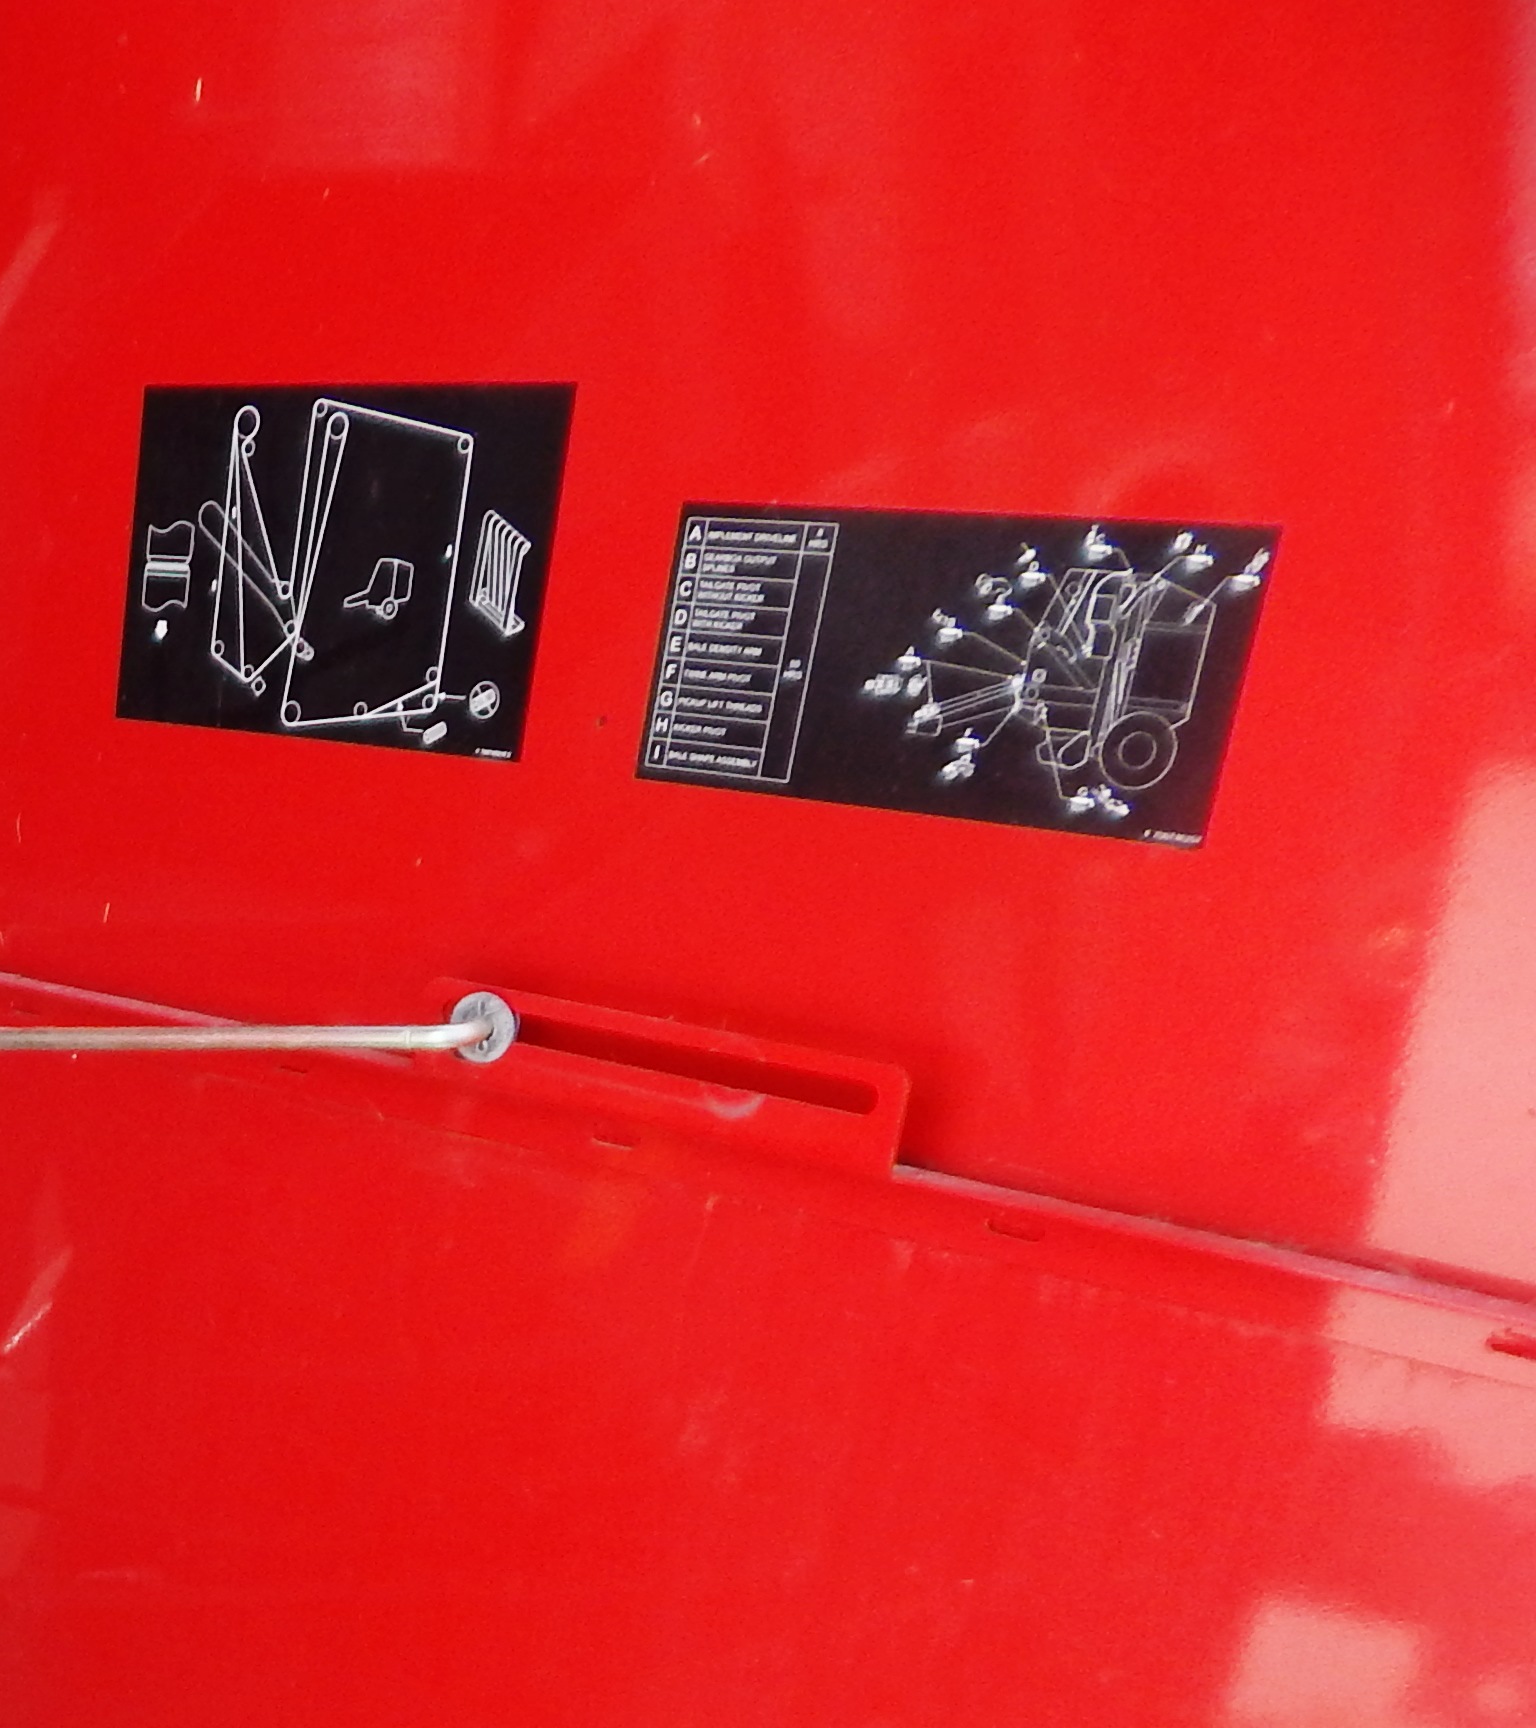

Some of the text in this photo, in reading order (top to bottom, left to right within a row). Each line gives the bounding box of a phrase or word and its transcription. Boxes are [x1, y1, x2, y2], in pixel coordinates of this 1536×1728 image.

[689, 525, 702, 541] A
[684, 552, 697, 569] B
[679, 580, 693, 597] C
[674, 608, 688, 625] D
[670, 636, 683, 652] E
[665, 663, 678, 679] F
[660, 691, 674, 707] G
[655, 717, 669, 733] H
[653, 744, 660, 760] I
